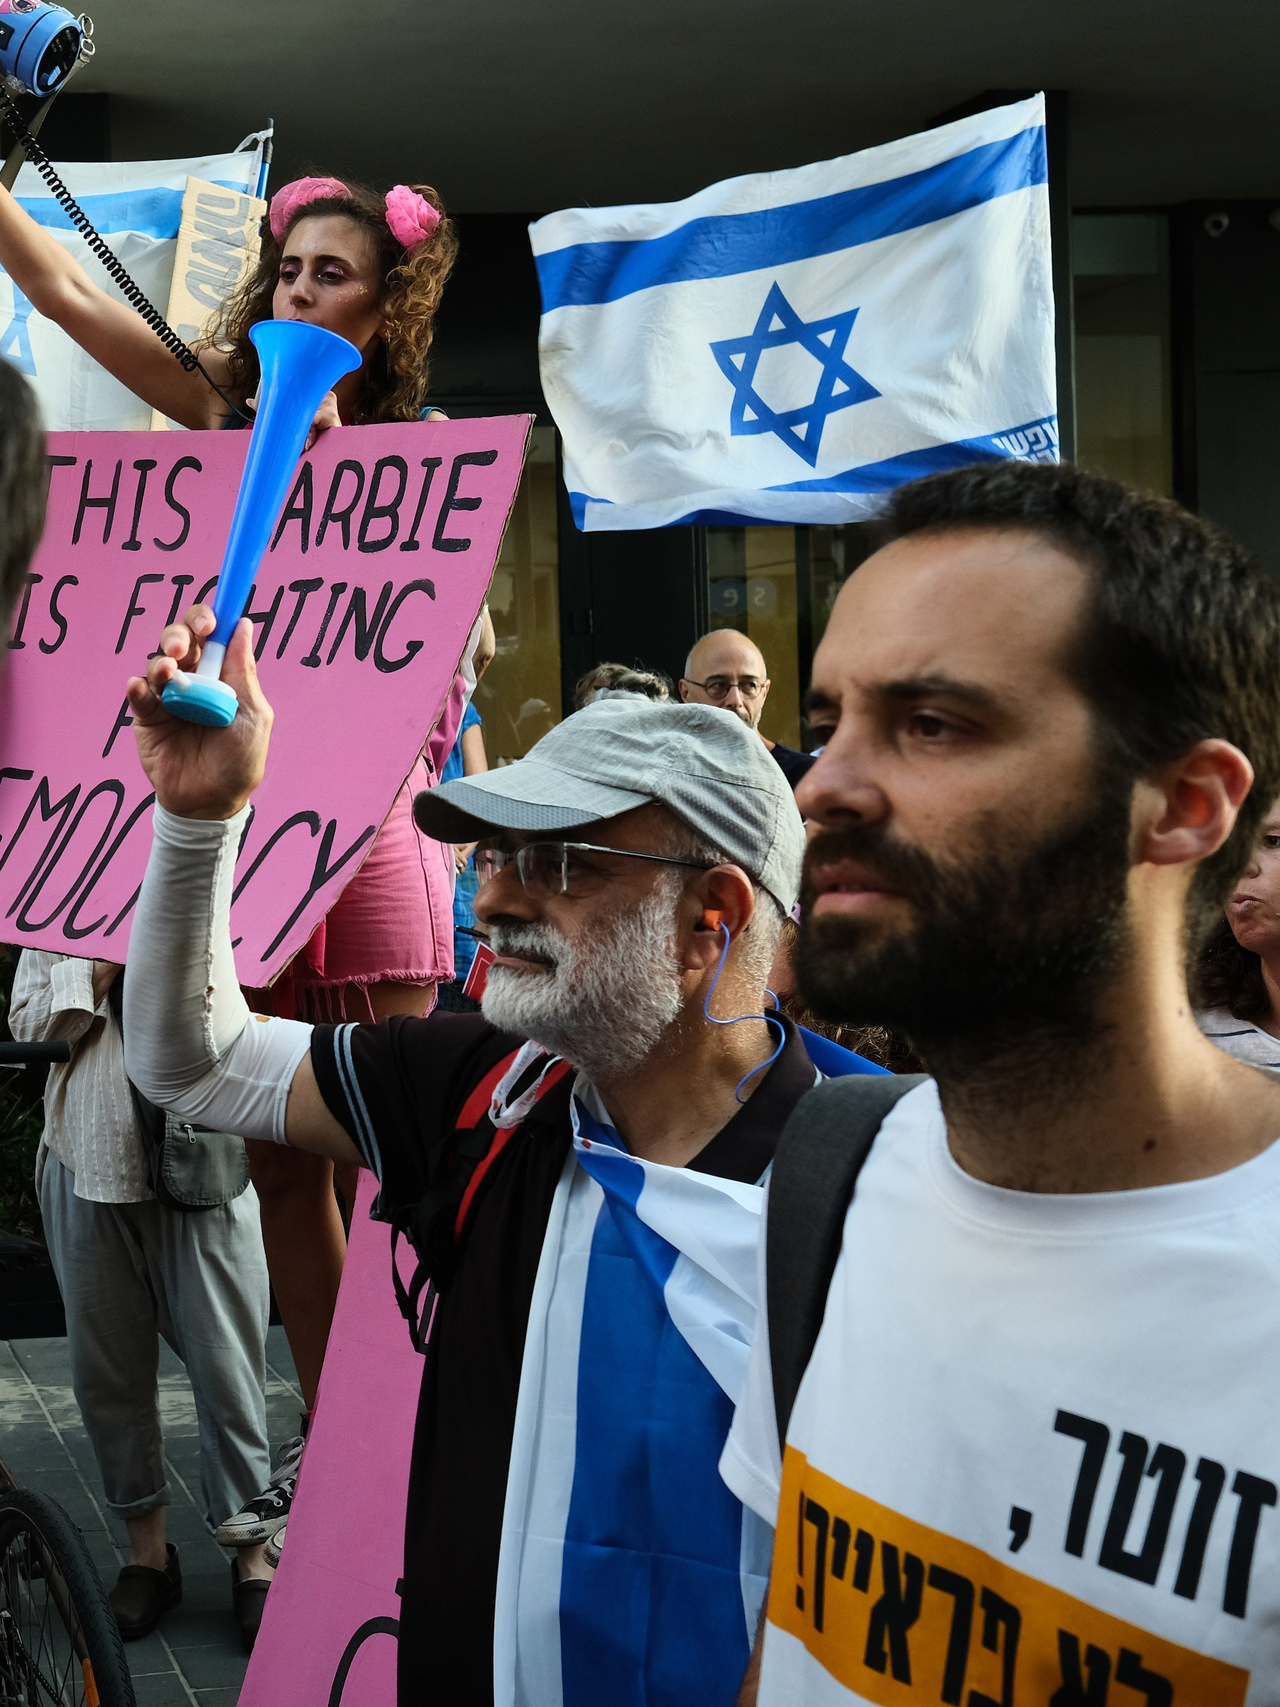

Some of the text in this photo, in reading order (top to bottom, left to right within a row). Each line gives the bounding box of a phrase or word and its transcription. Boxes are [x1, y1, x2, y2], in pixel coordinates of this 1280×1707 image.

[269, 449, 499, 554] ARBIE
[8, 573, 436, 674] IS FIHTING
